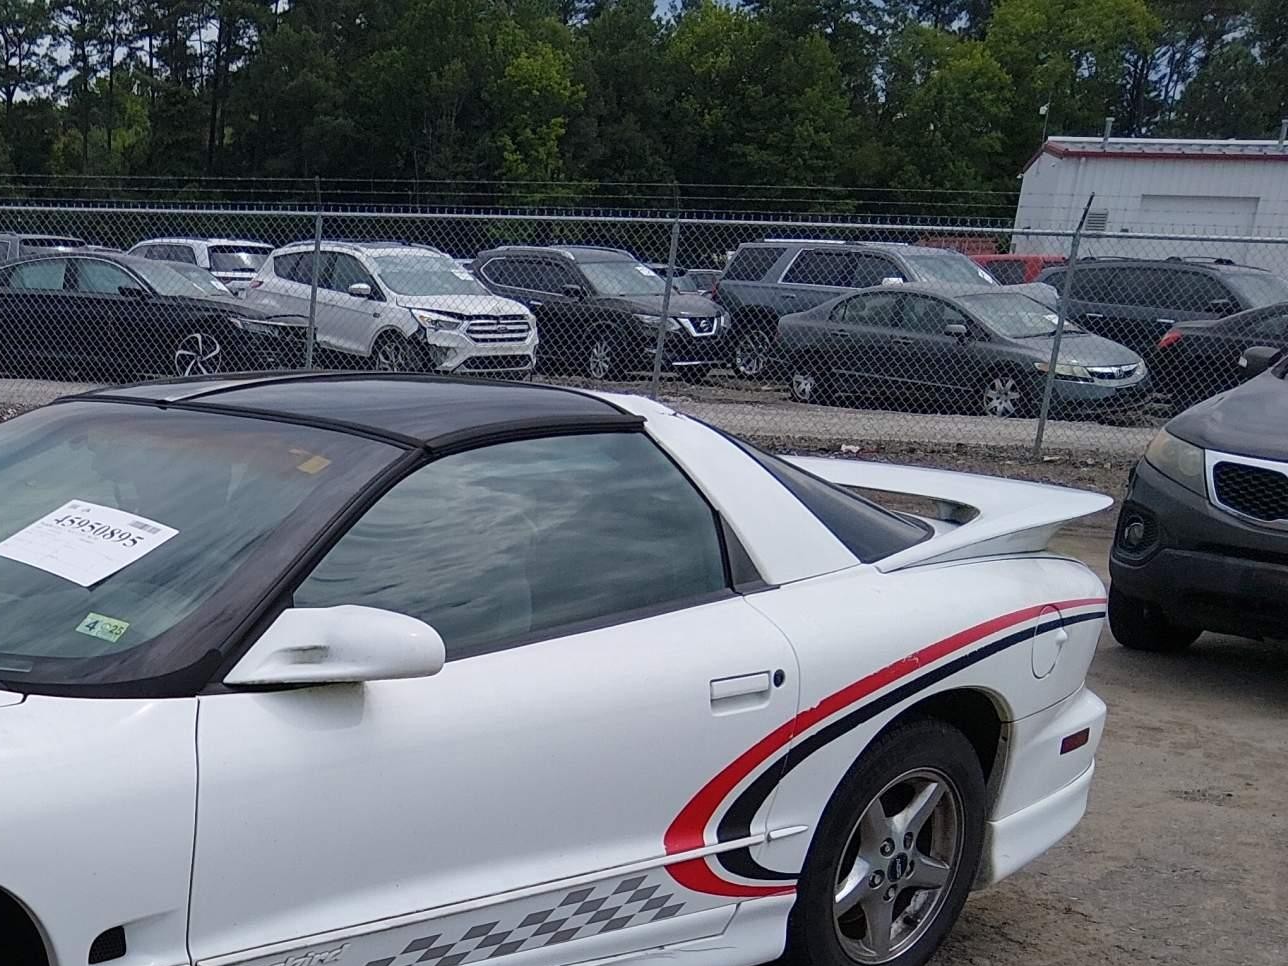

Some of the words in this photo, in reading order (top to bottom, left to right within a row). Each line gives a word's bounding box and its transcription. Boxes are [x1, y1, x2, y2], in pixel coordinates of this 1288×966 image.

[54, 514, 144, 548] 45950895
[85, 620, 99, 631] 4
[109, 624, 124, 635] 25
